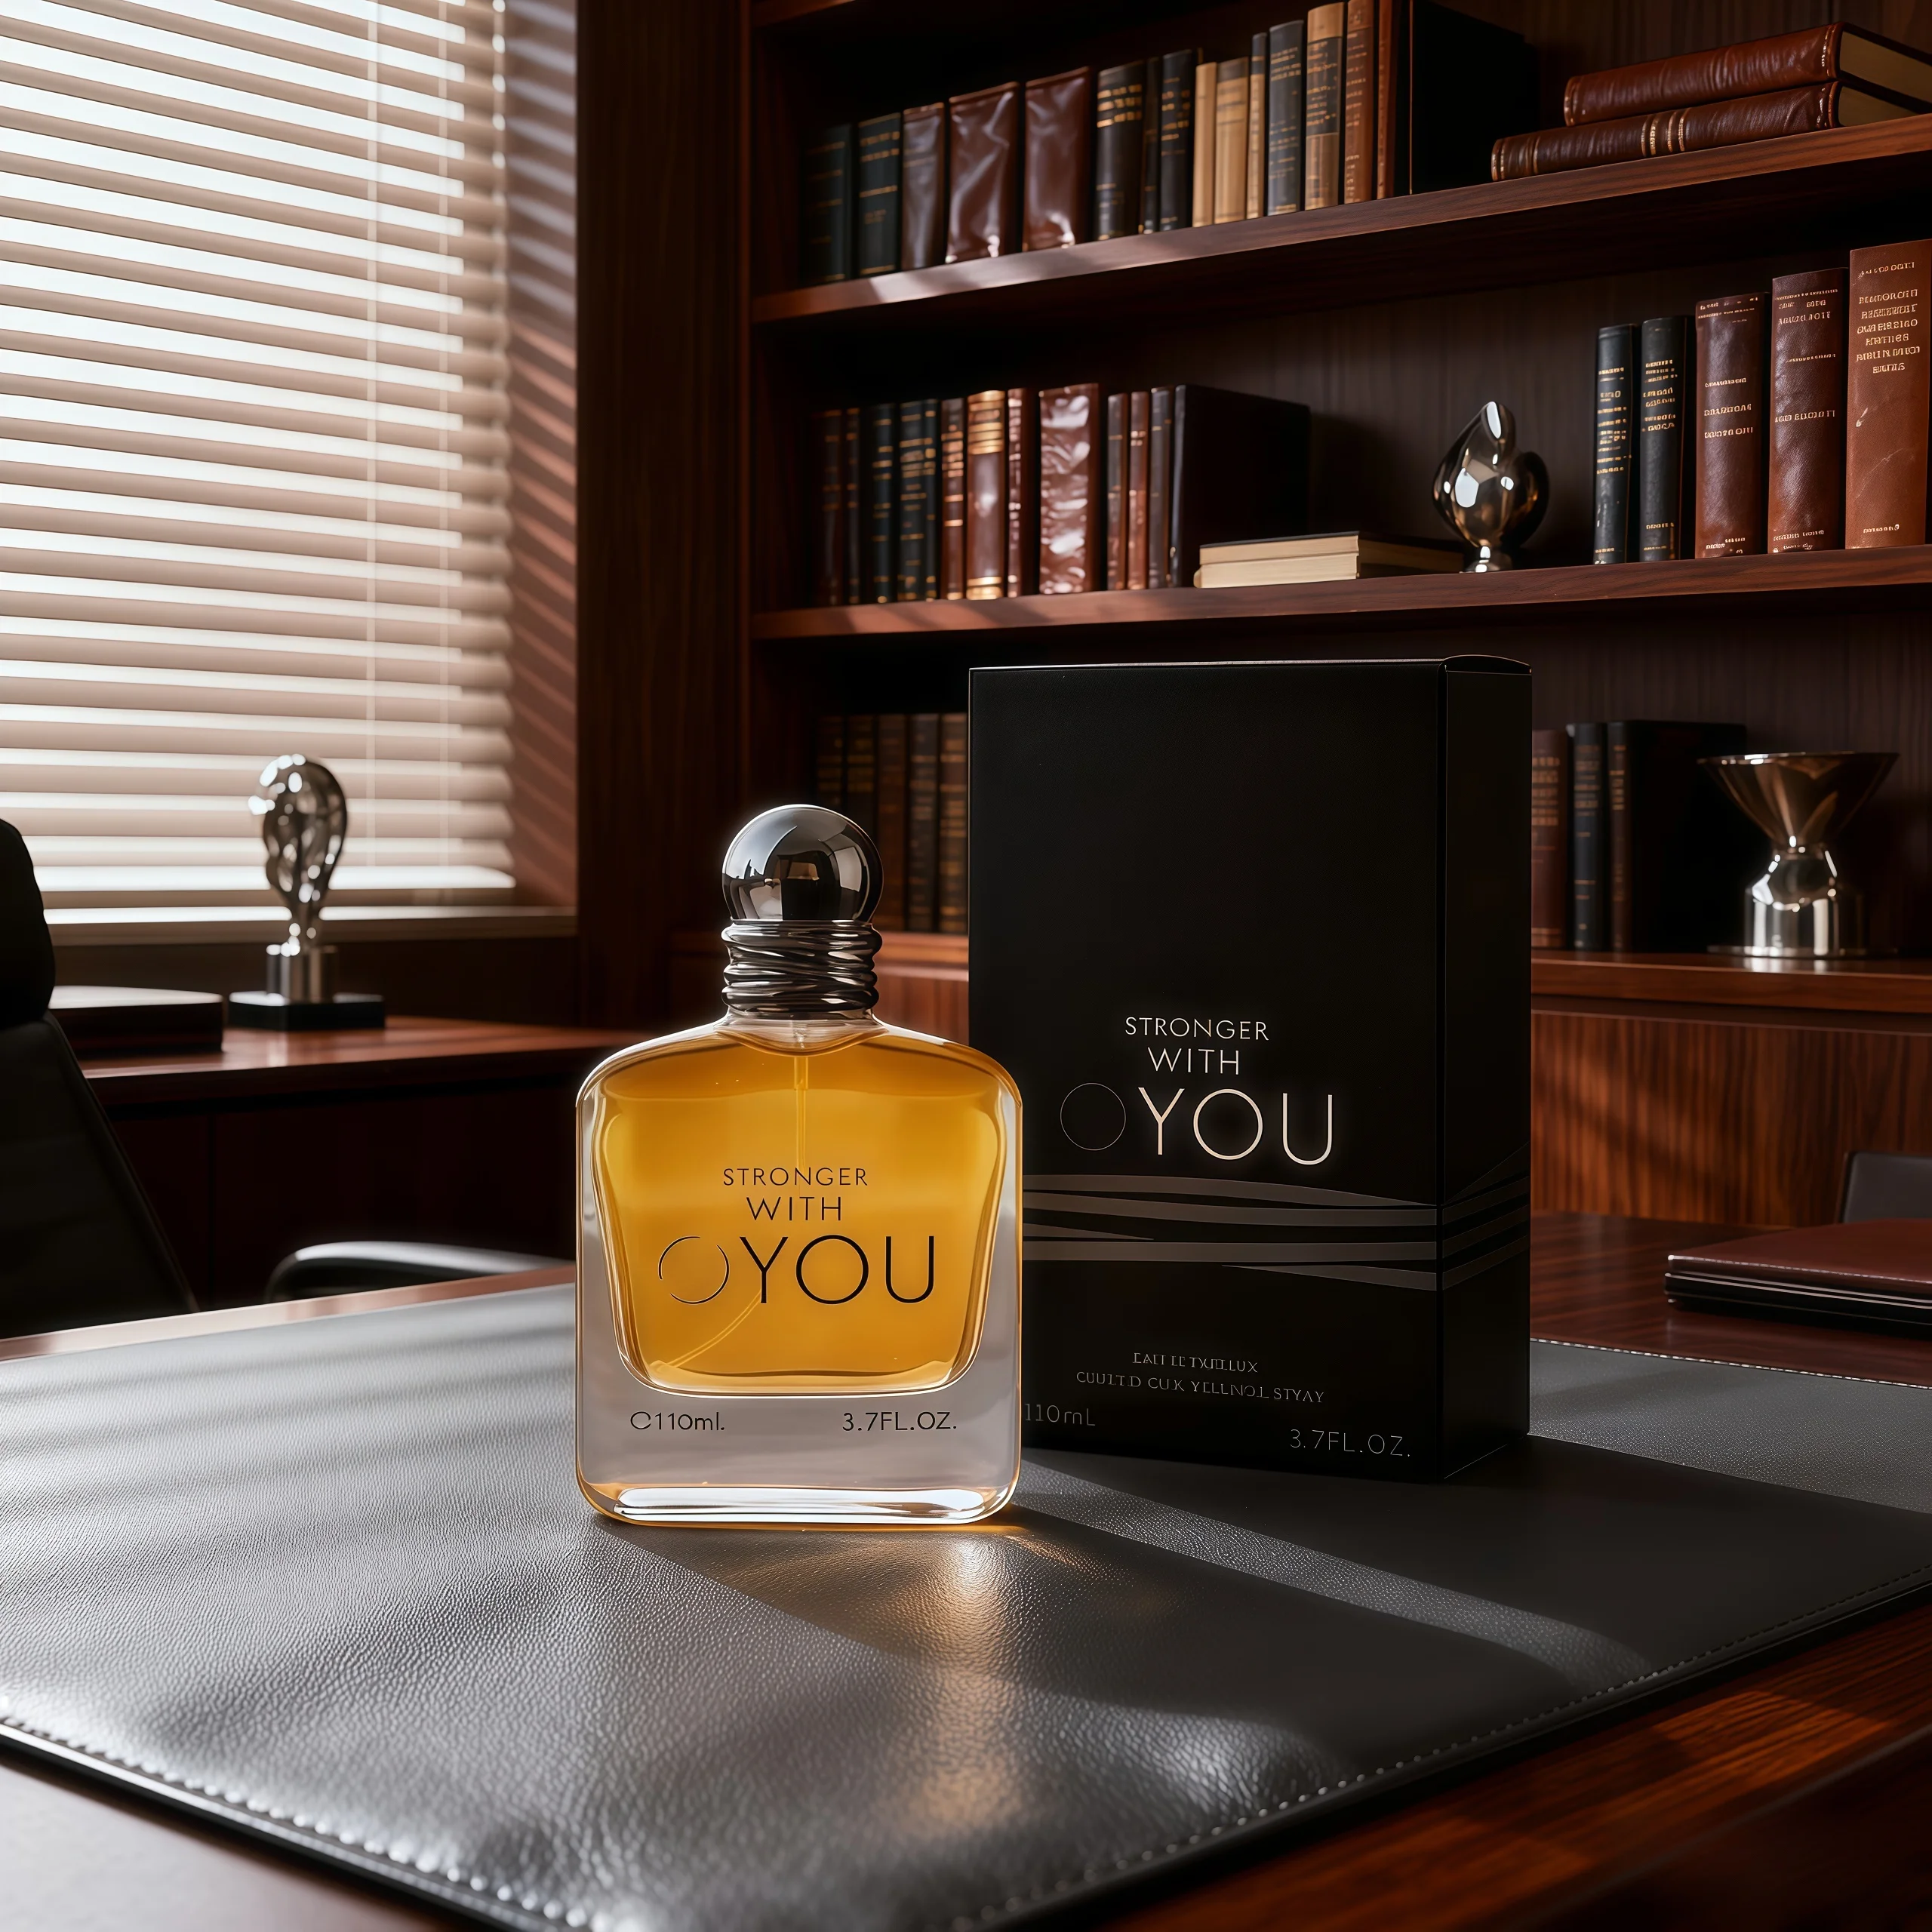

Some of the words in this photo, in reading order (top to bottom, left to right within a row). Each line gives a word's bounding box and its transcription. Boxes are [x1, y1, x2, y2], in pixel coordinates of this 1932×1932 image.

[1124, 1016, 1269, 1041] STRONGER
[1147, 1047, 1240, 1076] WITH
[723, 1167, 869, 1187] STRONGER
[746, 1196, 842, 1221] WITH
[842, 1411, 957, 1432] 3.7FL.OZ.
[1290, 1429, 1411, 1457] 3.7FL.OZ.
